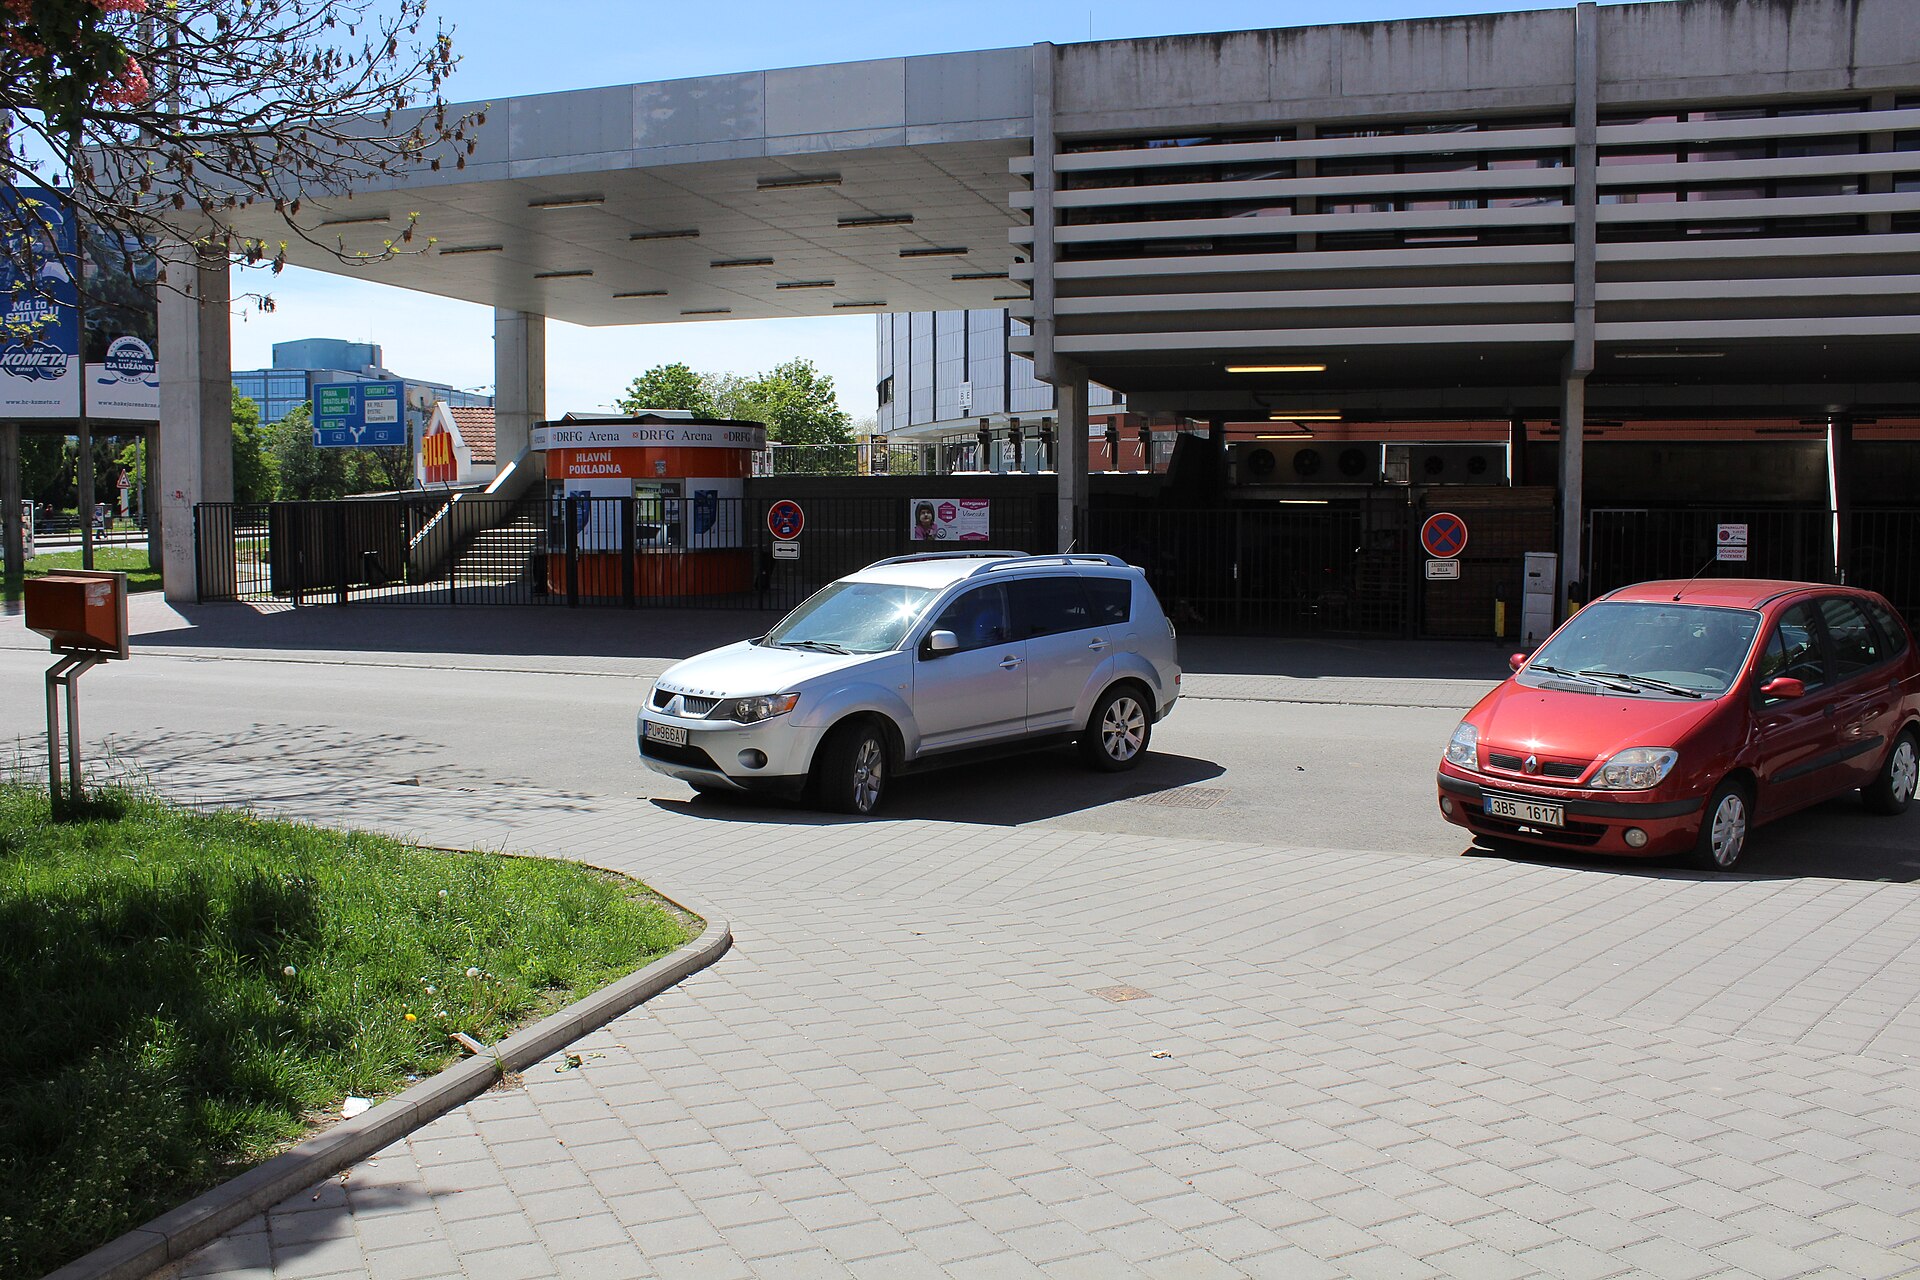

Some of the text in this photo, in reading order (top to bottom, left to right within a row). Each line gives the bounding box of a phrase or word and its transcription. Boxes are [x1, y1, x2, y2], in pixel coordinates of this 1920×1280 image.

[12, 300, 47, 311] Má to
[0, 353, 67, 366] KOMETA
[119, 362, 154, 371] LUŽÁNKY
[556, 430, 620, 442] DRFG Arena
[640, 430, 713, 441] DRFG Arena
[728, 431, 751, 442] DRFG
[422, 432, 450, 467] BILLA
[576, 450, 612, 462] HLAVNÍ
[569, 464, 622, 474] POKLADNA
[1494, 800, 1556, 821] 3B5 1617
